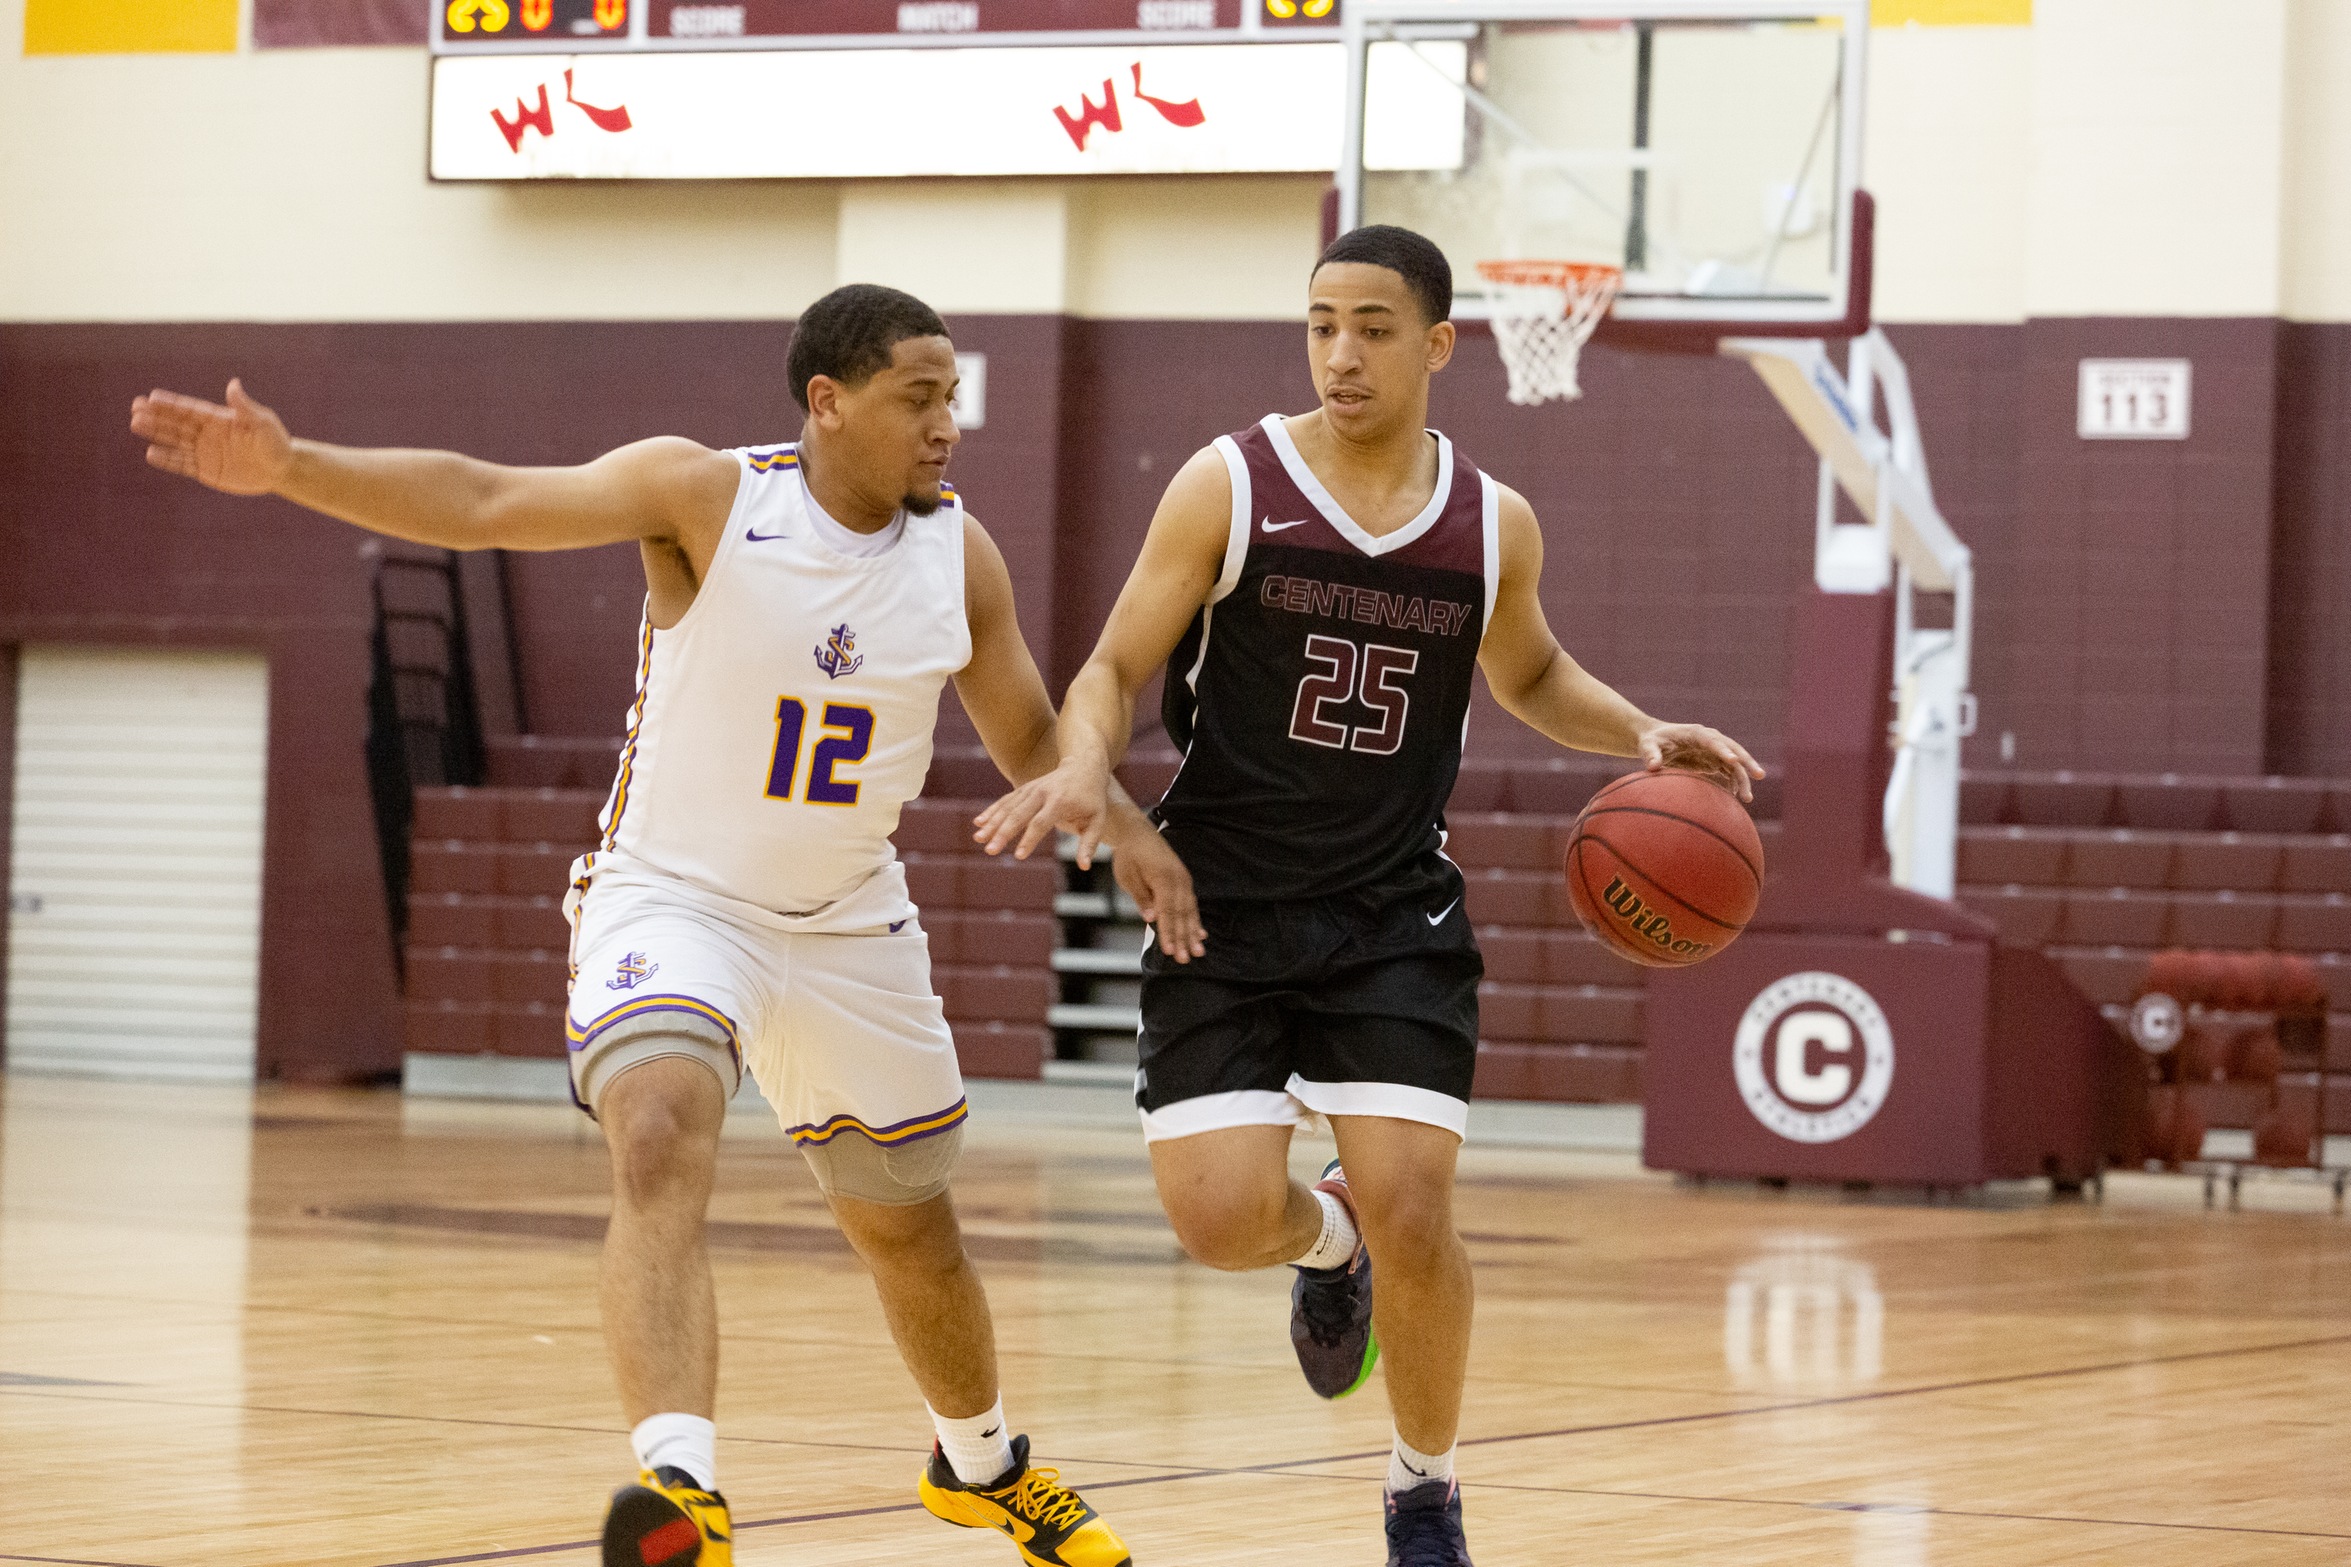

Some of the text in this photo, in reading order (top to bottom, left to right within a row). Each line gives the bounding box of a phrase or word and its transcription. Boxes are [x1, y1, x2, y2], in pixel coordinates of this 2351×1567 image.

[2102, 391, 2169, 428] 113
[1261, 575, 1472, 636] CENTENARY
[1288, 634, 1419, 755] 25
[763, 694, 877, 807] 12
[1603, 873, 1713, 958] Wilson
[1776, 1011, 1852, 1105] C
